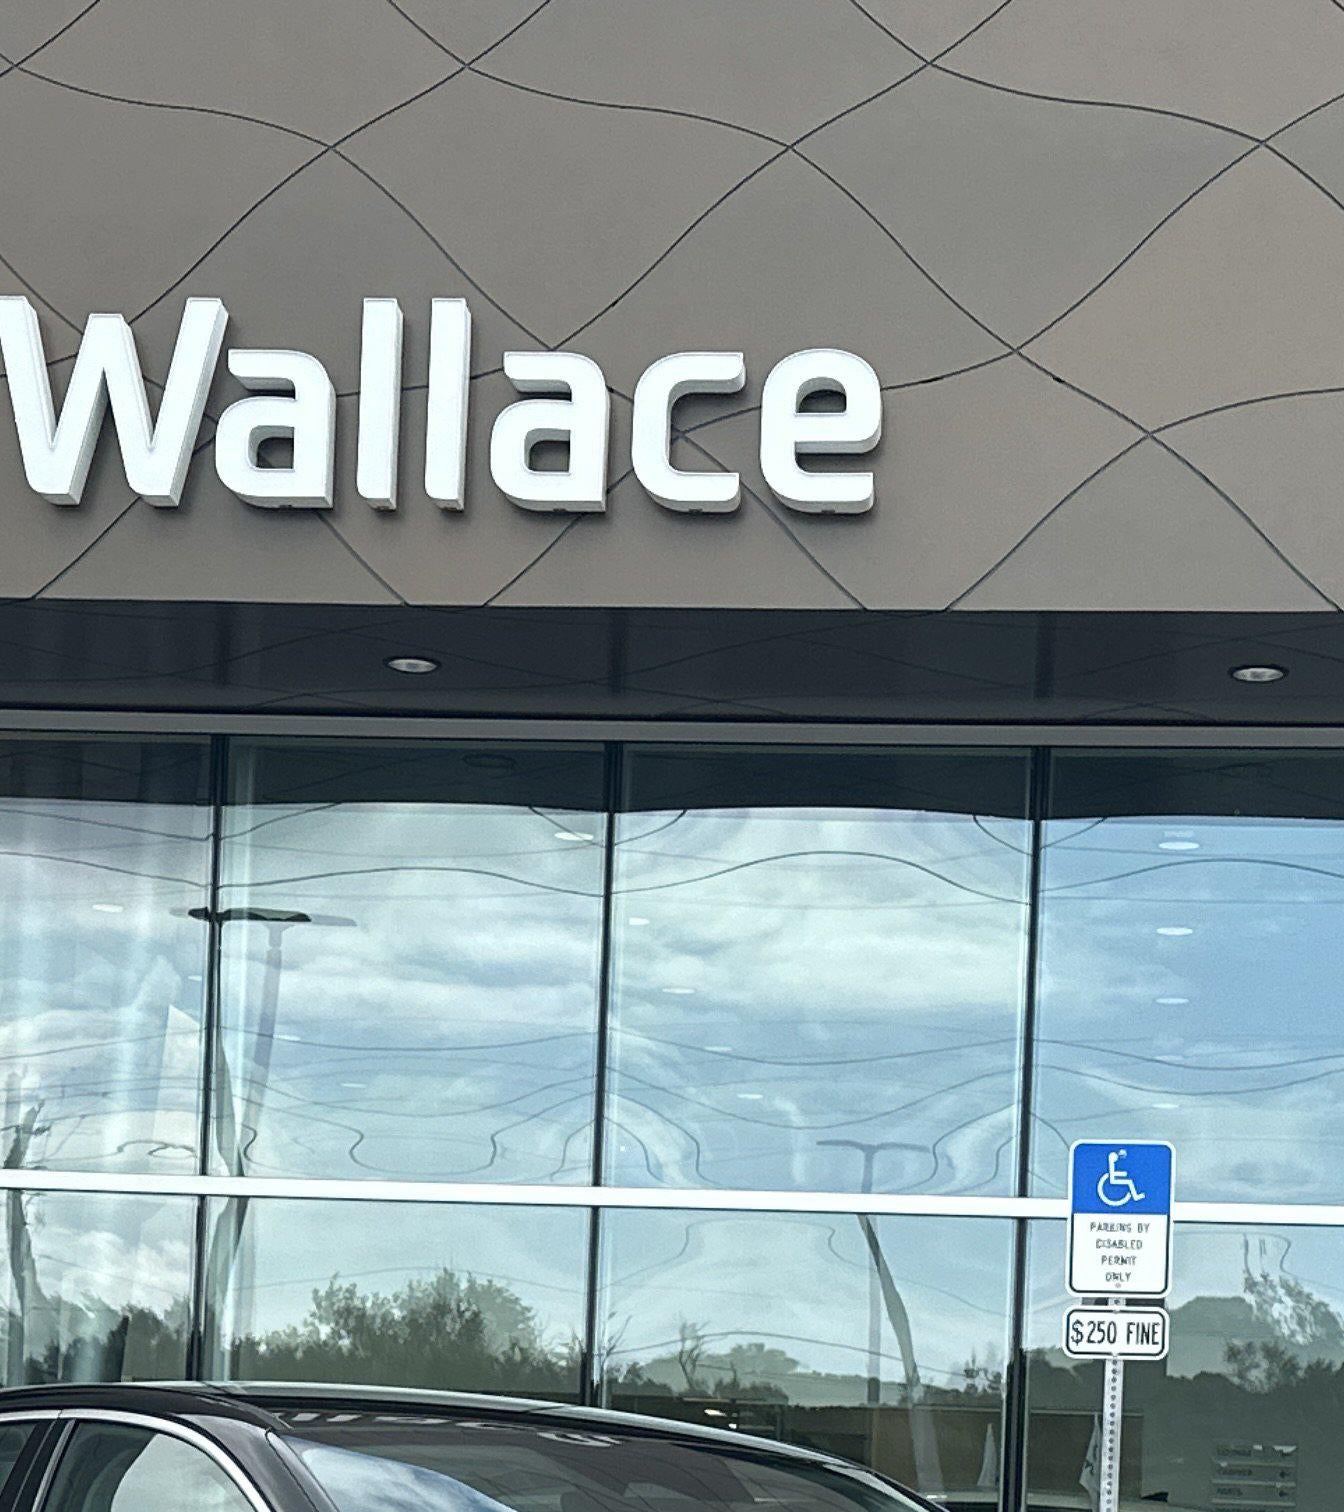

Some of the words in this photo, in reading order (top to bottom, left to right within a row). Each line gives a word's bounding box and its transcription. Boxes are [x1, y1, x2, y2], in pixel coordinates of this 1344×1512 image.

[1089, 1221, 1132, 1233] PARKING
[1137, 1223, 1151, 1233] BY
[1095, 1238, 1143, 1250] DISABLED
[1101, 1255, 1137, 1266] PERMIT
[1105, 1272, 1132, 1282] ONLY
[1071, 1319, 1118, 1346] $250
[1126, 1322, 1160, 1346] FINE
